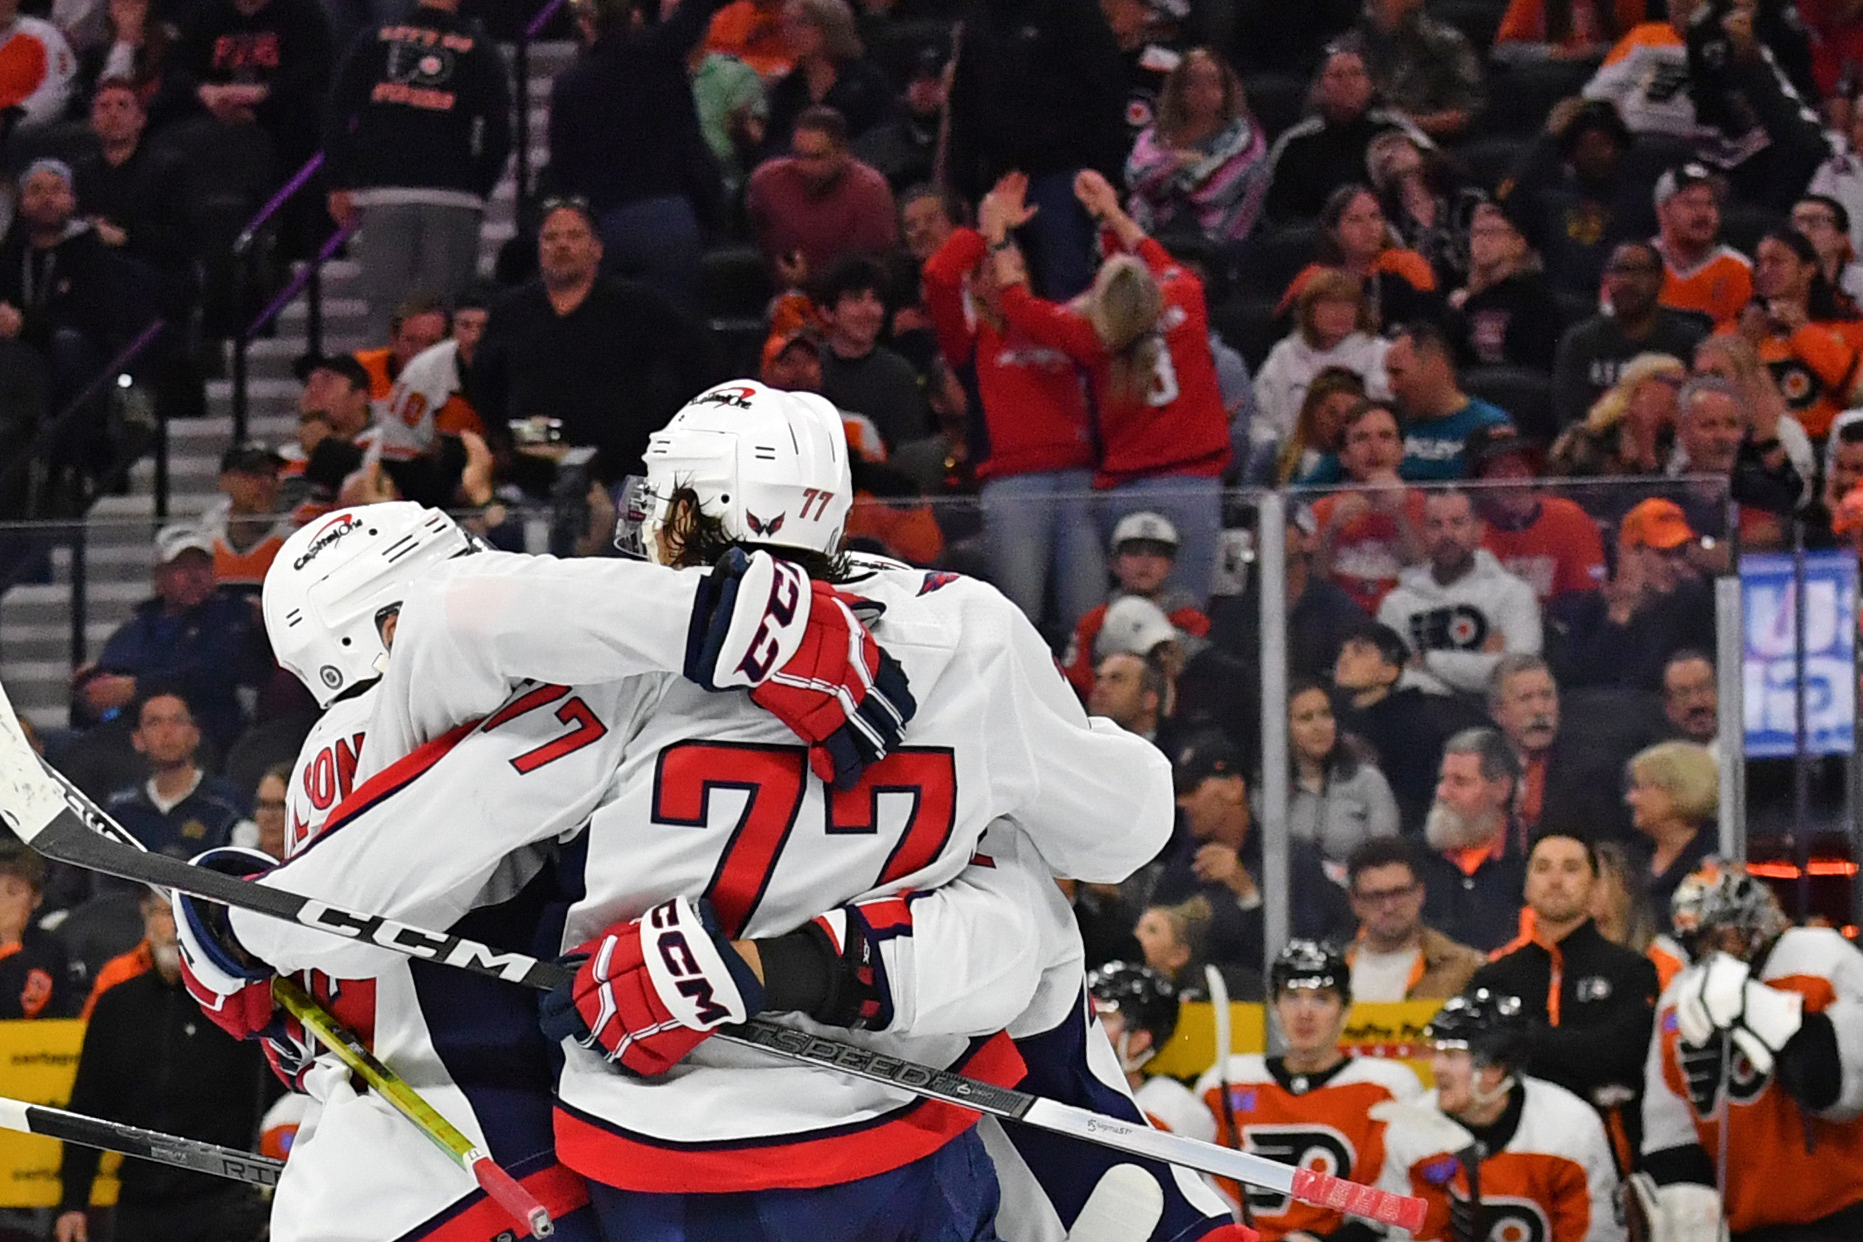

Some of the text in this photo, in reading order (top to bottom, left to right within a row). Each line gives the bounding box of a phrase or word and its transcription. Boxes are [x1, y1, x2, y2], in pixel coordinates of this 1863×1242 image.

[799, 488, 835, 522] 77
[651, 738, 957, 940] 77
[296, 898, 538, 984] CCM
[650, 898, 733, 1025] CCM
